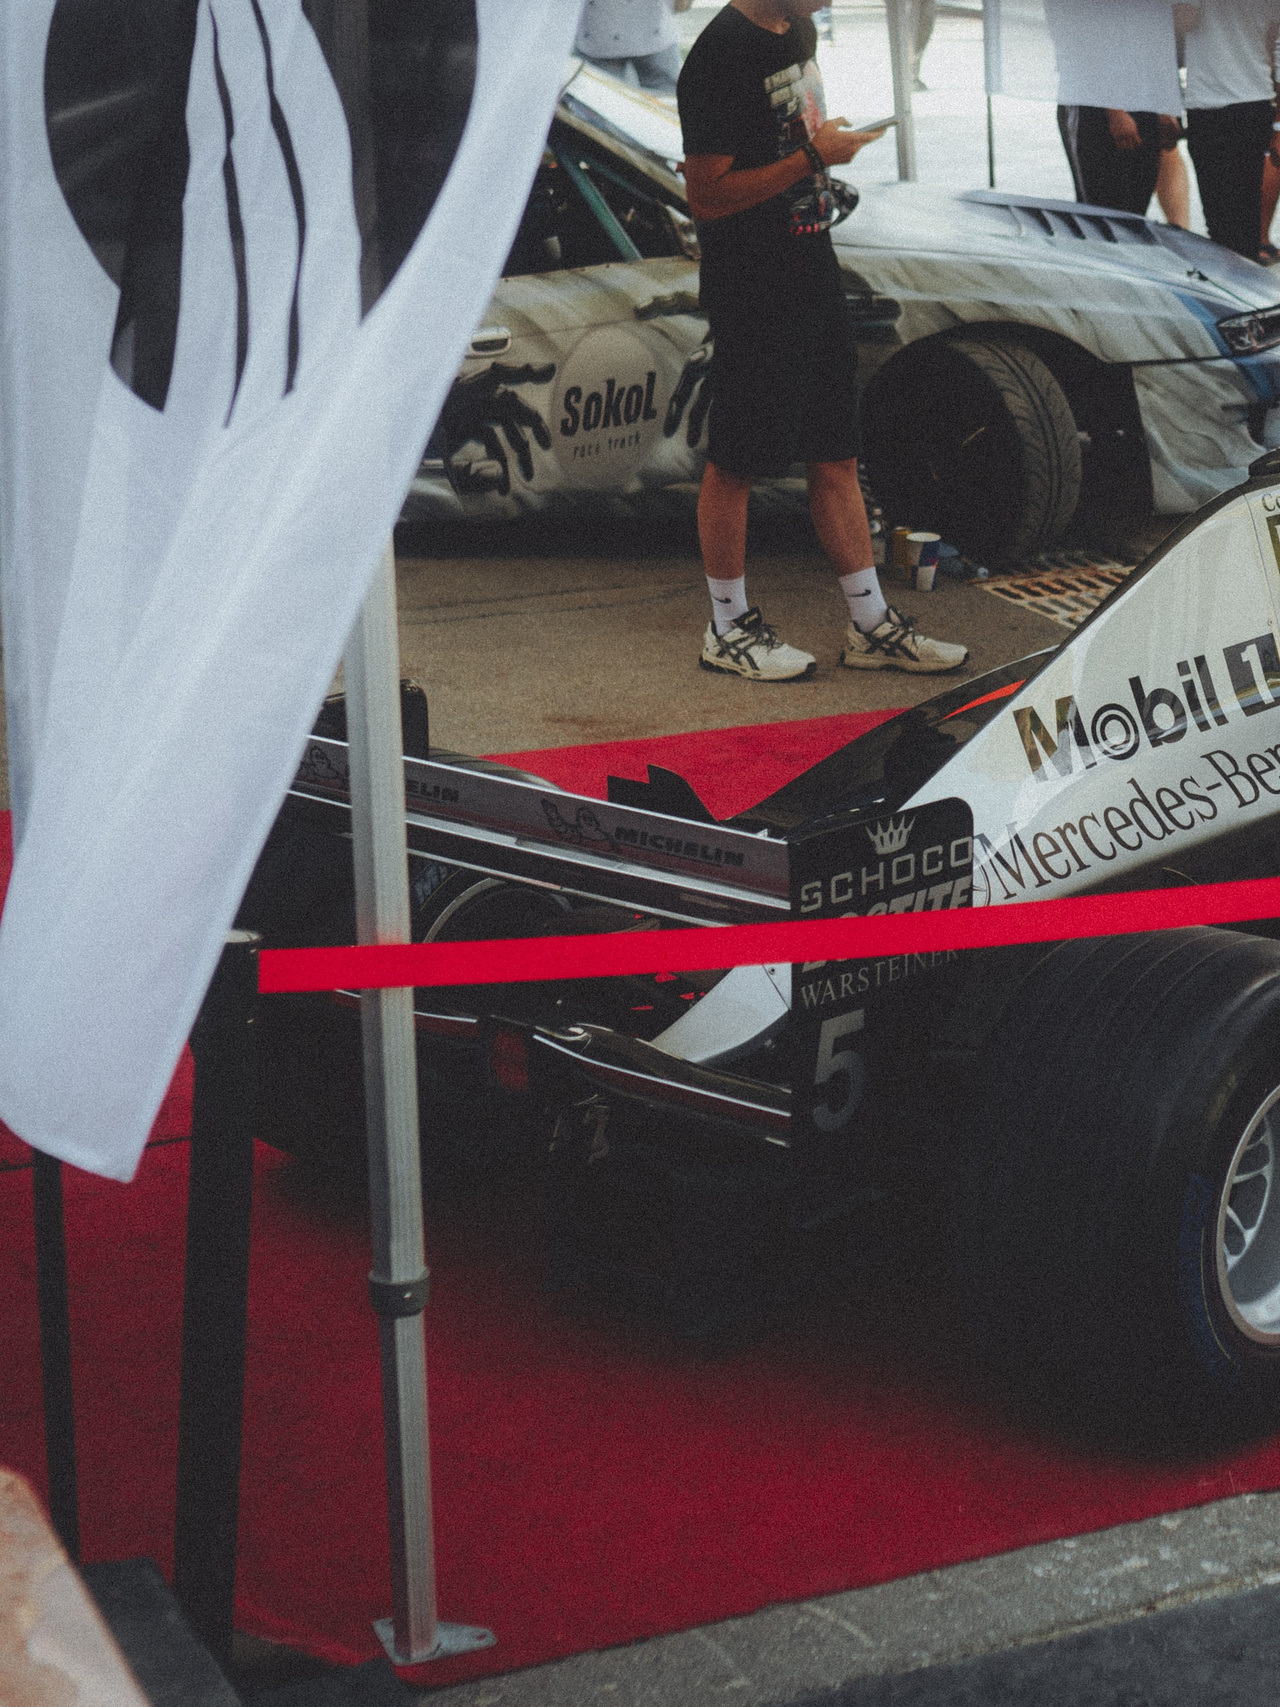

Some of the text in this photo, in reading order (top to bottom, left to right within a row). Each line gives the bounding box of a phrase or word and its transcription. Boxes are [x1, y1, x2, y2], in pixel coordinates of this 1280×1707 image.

[1012, 654, 1229, 783] Mobil
[614, 825, 745, 867] MICHELIN
[812, 1009, 865, 1132] 5
